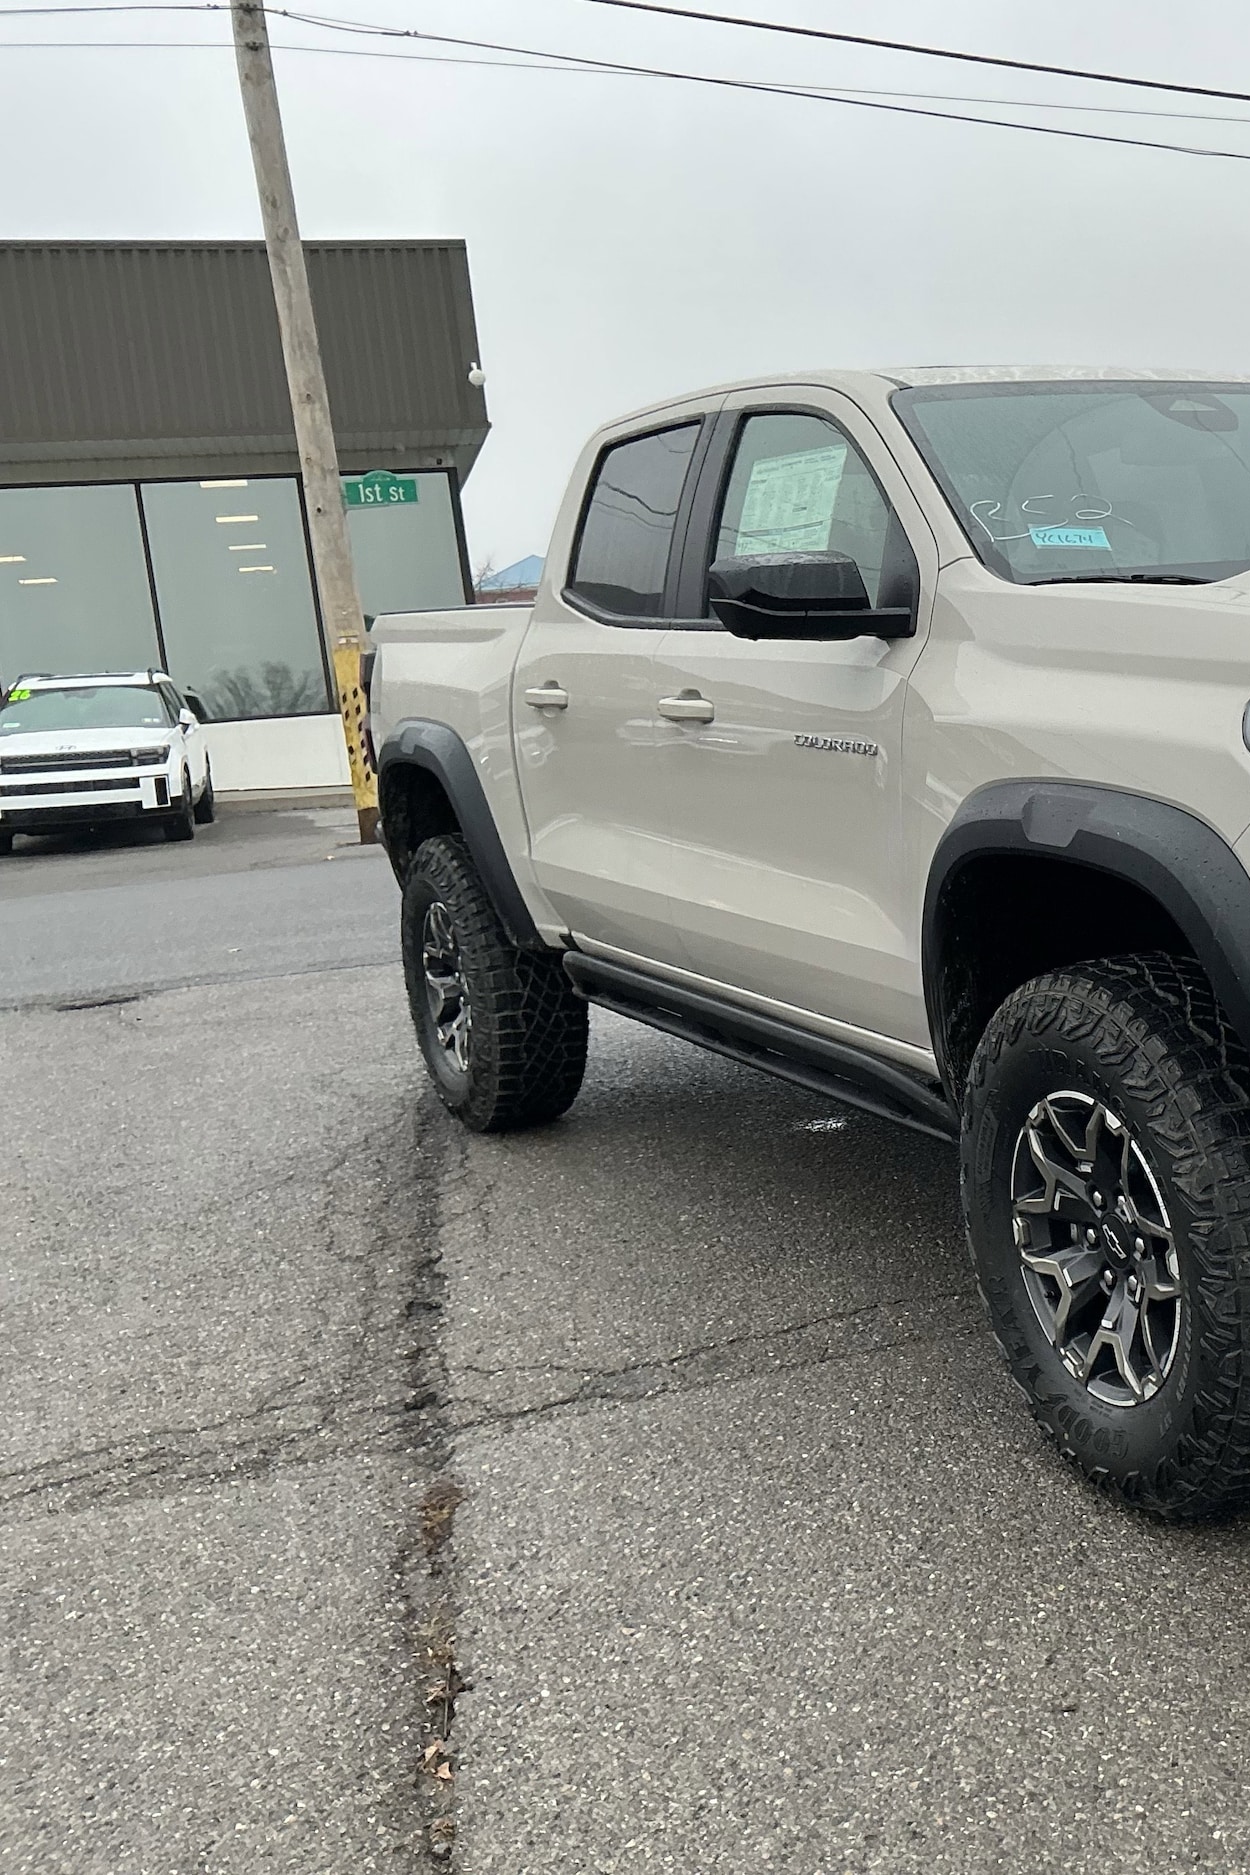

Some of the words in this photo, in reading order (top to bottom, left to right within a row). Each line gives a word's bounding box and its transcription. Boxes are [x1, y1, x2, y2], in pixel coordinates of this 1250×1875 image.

[358, 483, 383, 503] 1st
[389, 486, 405, 502] St
[793, 733, 878, 756] COLORADO
